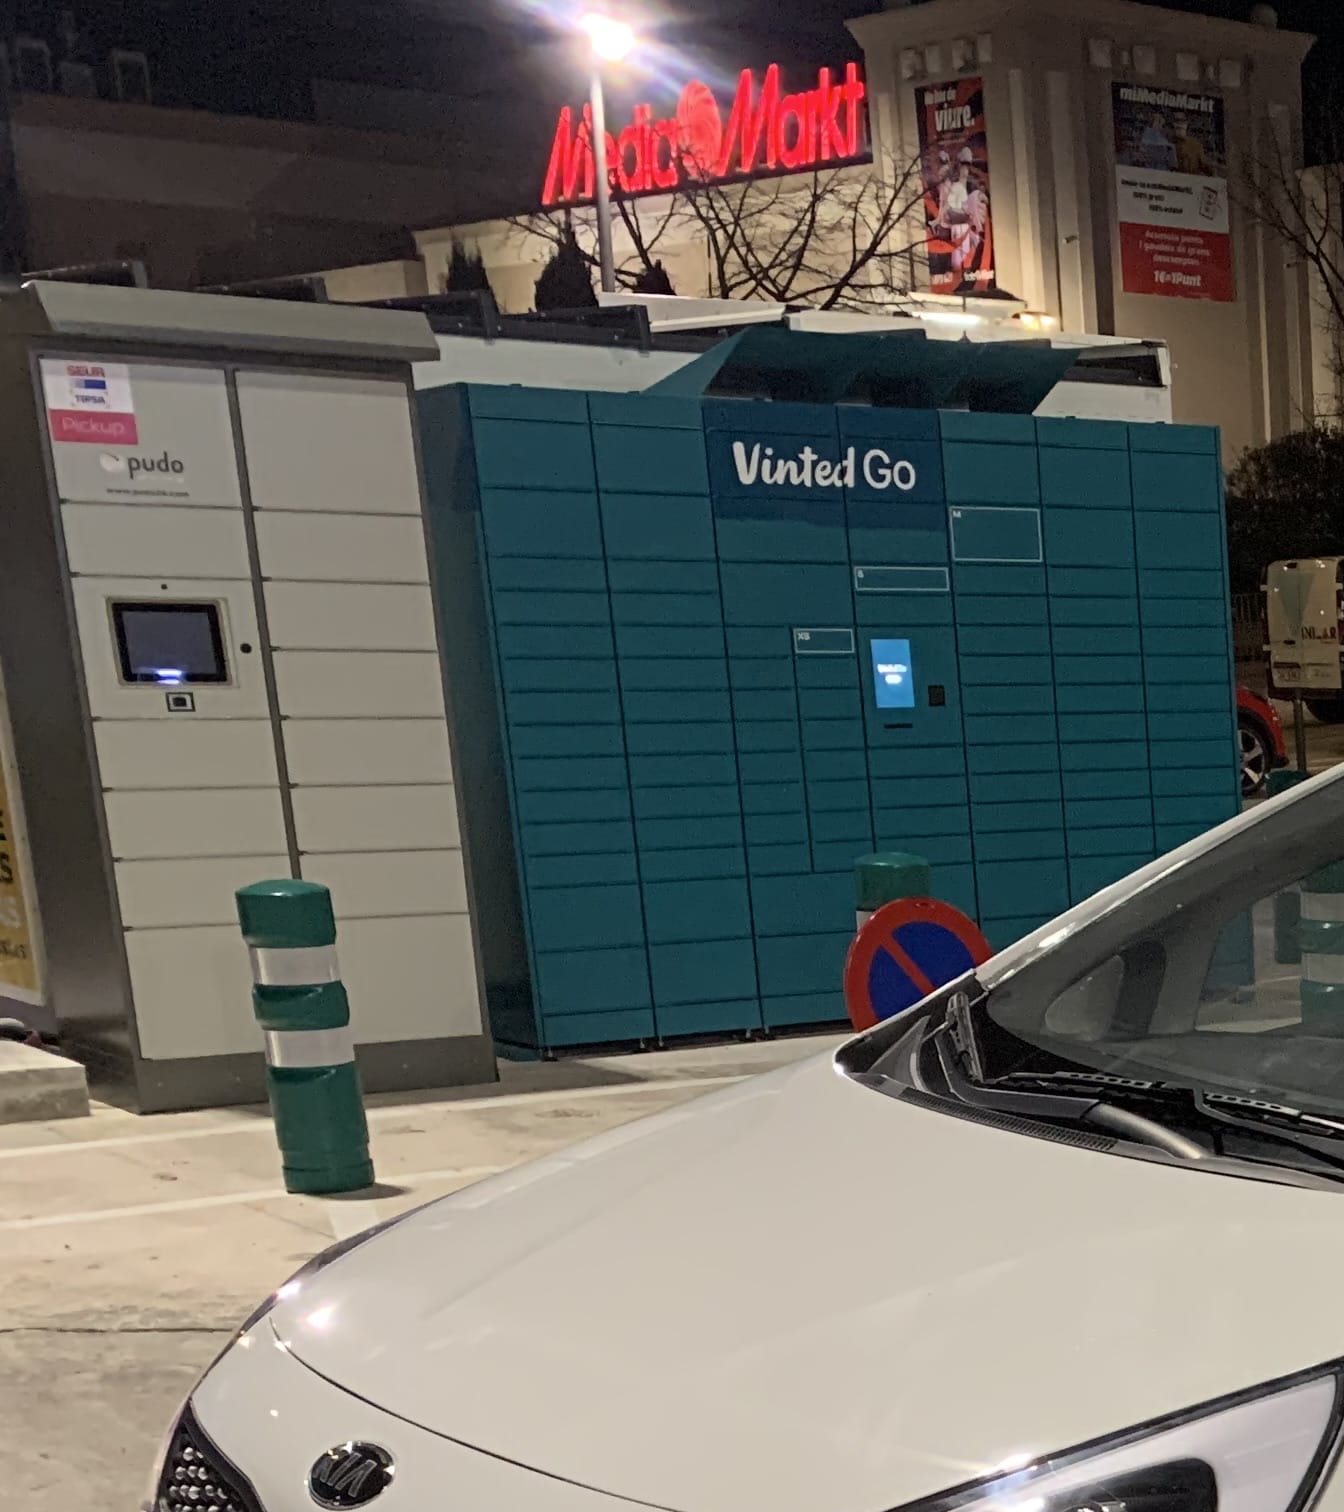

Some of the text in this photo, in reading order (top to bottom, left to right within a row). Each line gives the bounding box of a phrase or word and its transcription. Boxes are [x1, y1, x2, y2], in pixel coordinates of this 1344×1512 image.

[712, 62, 865, 177] Markt
[61, 416, 125, 437] Pickup
[127, 451, 184, 480] pudo
[732, 440, 916, 490] Vinted Go
